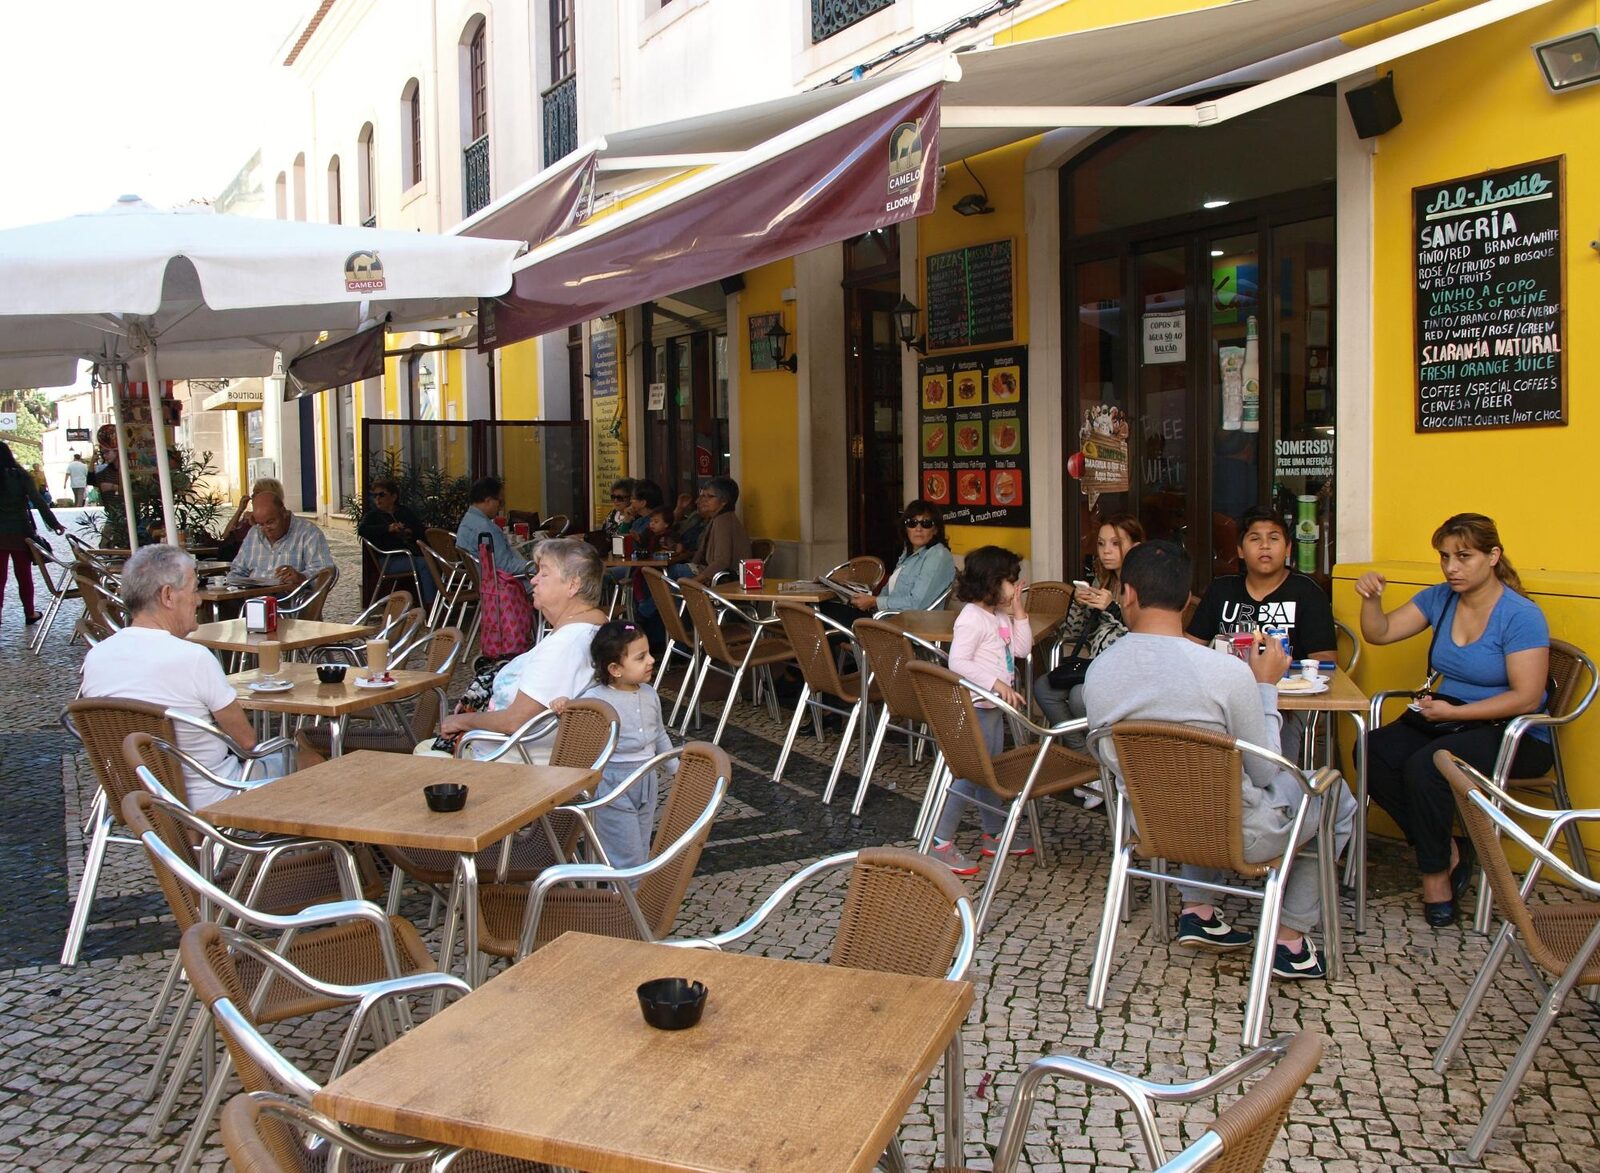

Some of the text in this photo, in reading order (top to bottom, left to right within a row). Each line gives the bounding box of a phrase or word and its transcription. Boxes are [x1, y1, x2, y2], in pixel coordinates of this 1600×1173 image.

[889, 169, 920, 189] CAMELO
[886, 191, 921, 212] ELDORADO
[1499, 256, 1510, 265] DO
[1514, 248, 1555, 263] BOSQUE
[348, 281, 383, 289] CAMELO
[1434, 276, 1454, 288] RED
[1459, 271, 1492, 285] FRUITS
[1432, 279, 1536, 303] VINHO A COPO
[1429, 289, 1548, 317] GLASSES OF WINE
[1495, 334, 1561, 357] NATURAL
[1420, 355, 1556, 381] FRESH ORANGE JUICE
[228, 391, 264, 401] BOUTIQUE
[1421, 384, 1461, 399] COFFEE
[1421, 400, 1471, 414] CERVEJA
[1474, 414, 1510, 425] QUENTE
[1535, 409, 1561, 420] CHOC
[1140, 415, 1184, 441] FREE
[1275, 439, 1334, 456] SOMERSBY
[1285, 468, 1300, 476] MAIS
[976, 511, 992, 521] much
[992, 508, 1008, 518] more
